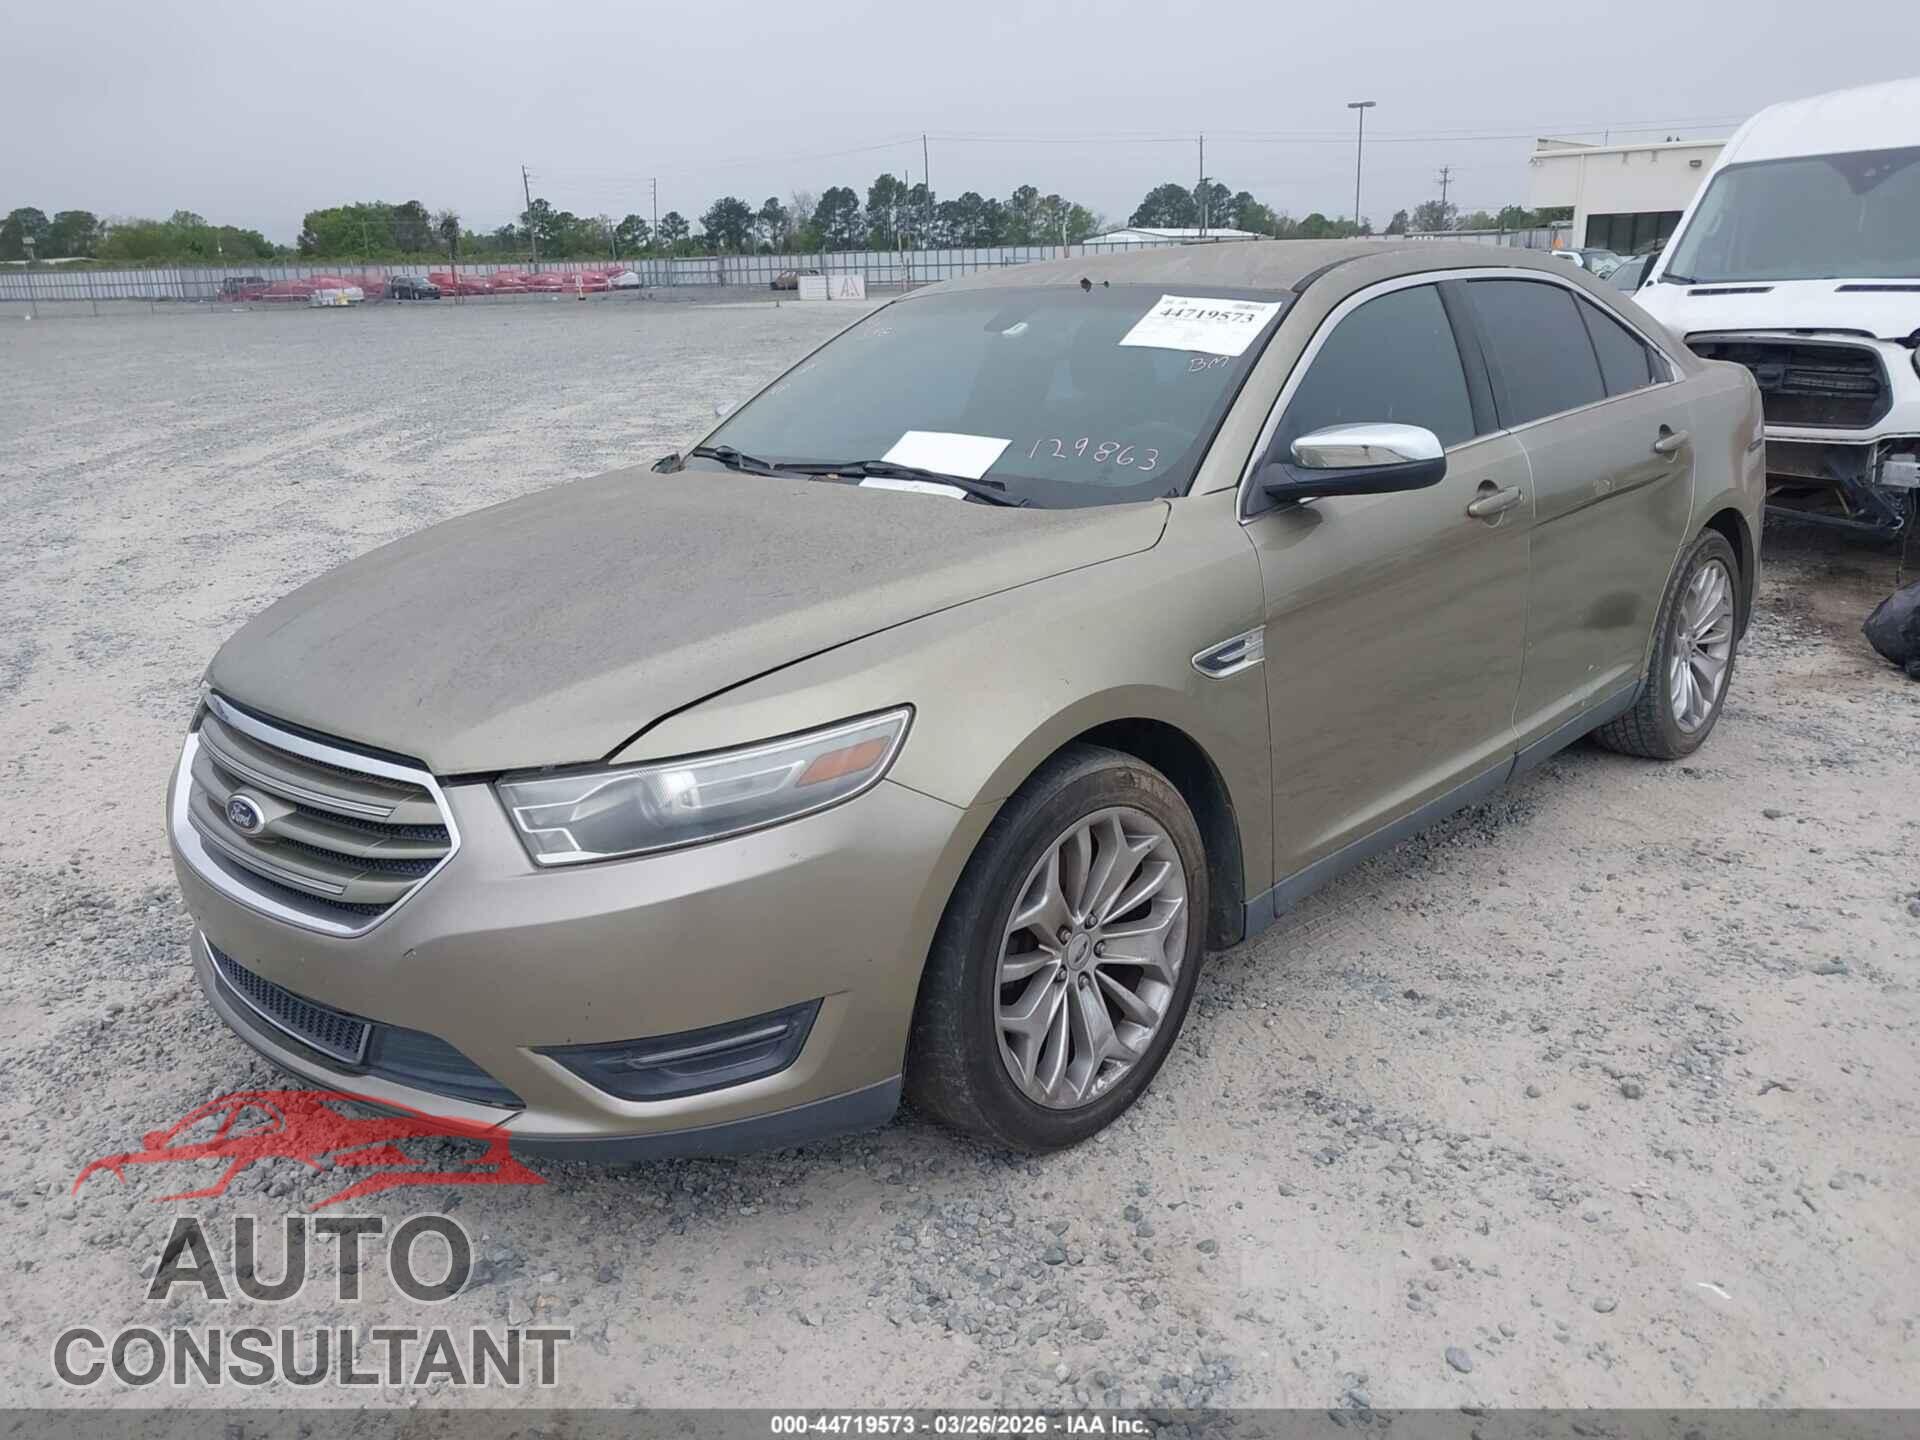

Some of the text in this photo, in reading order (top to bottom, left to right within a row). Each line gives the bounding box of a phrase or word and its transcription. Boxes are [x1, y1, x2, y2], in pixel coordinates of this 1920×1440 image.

[1160, 307, 1256, 323] 44719573
[1027, 436, 1159, 471] 129863
[230, 802, 253, 827] Ford
